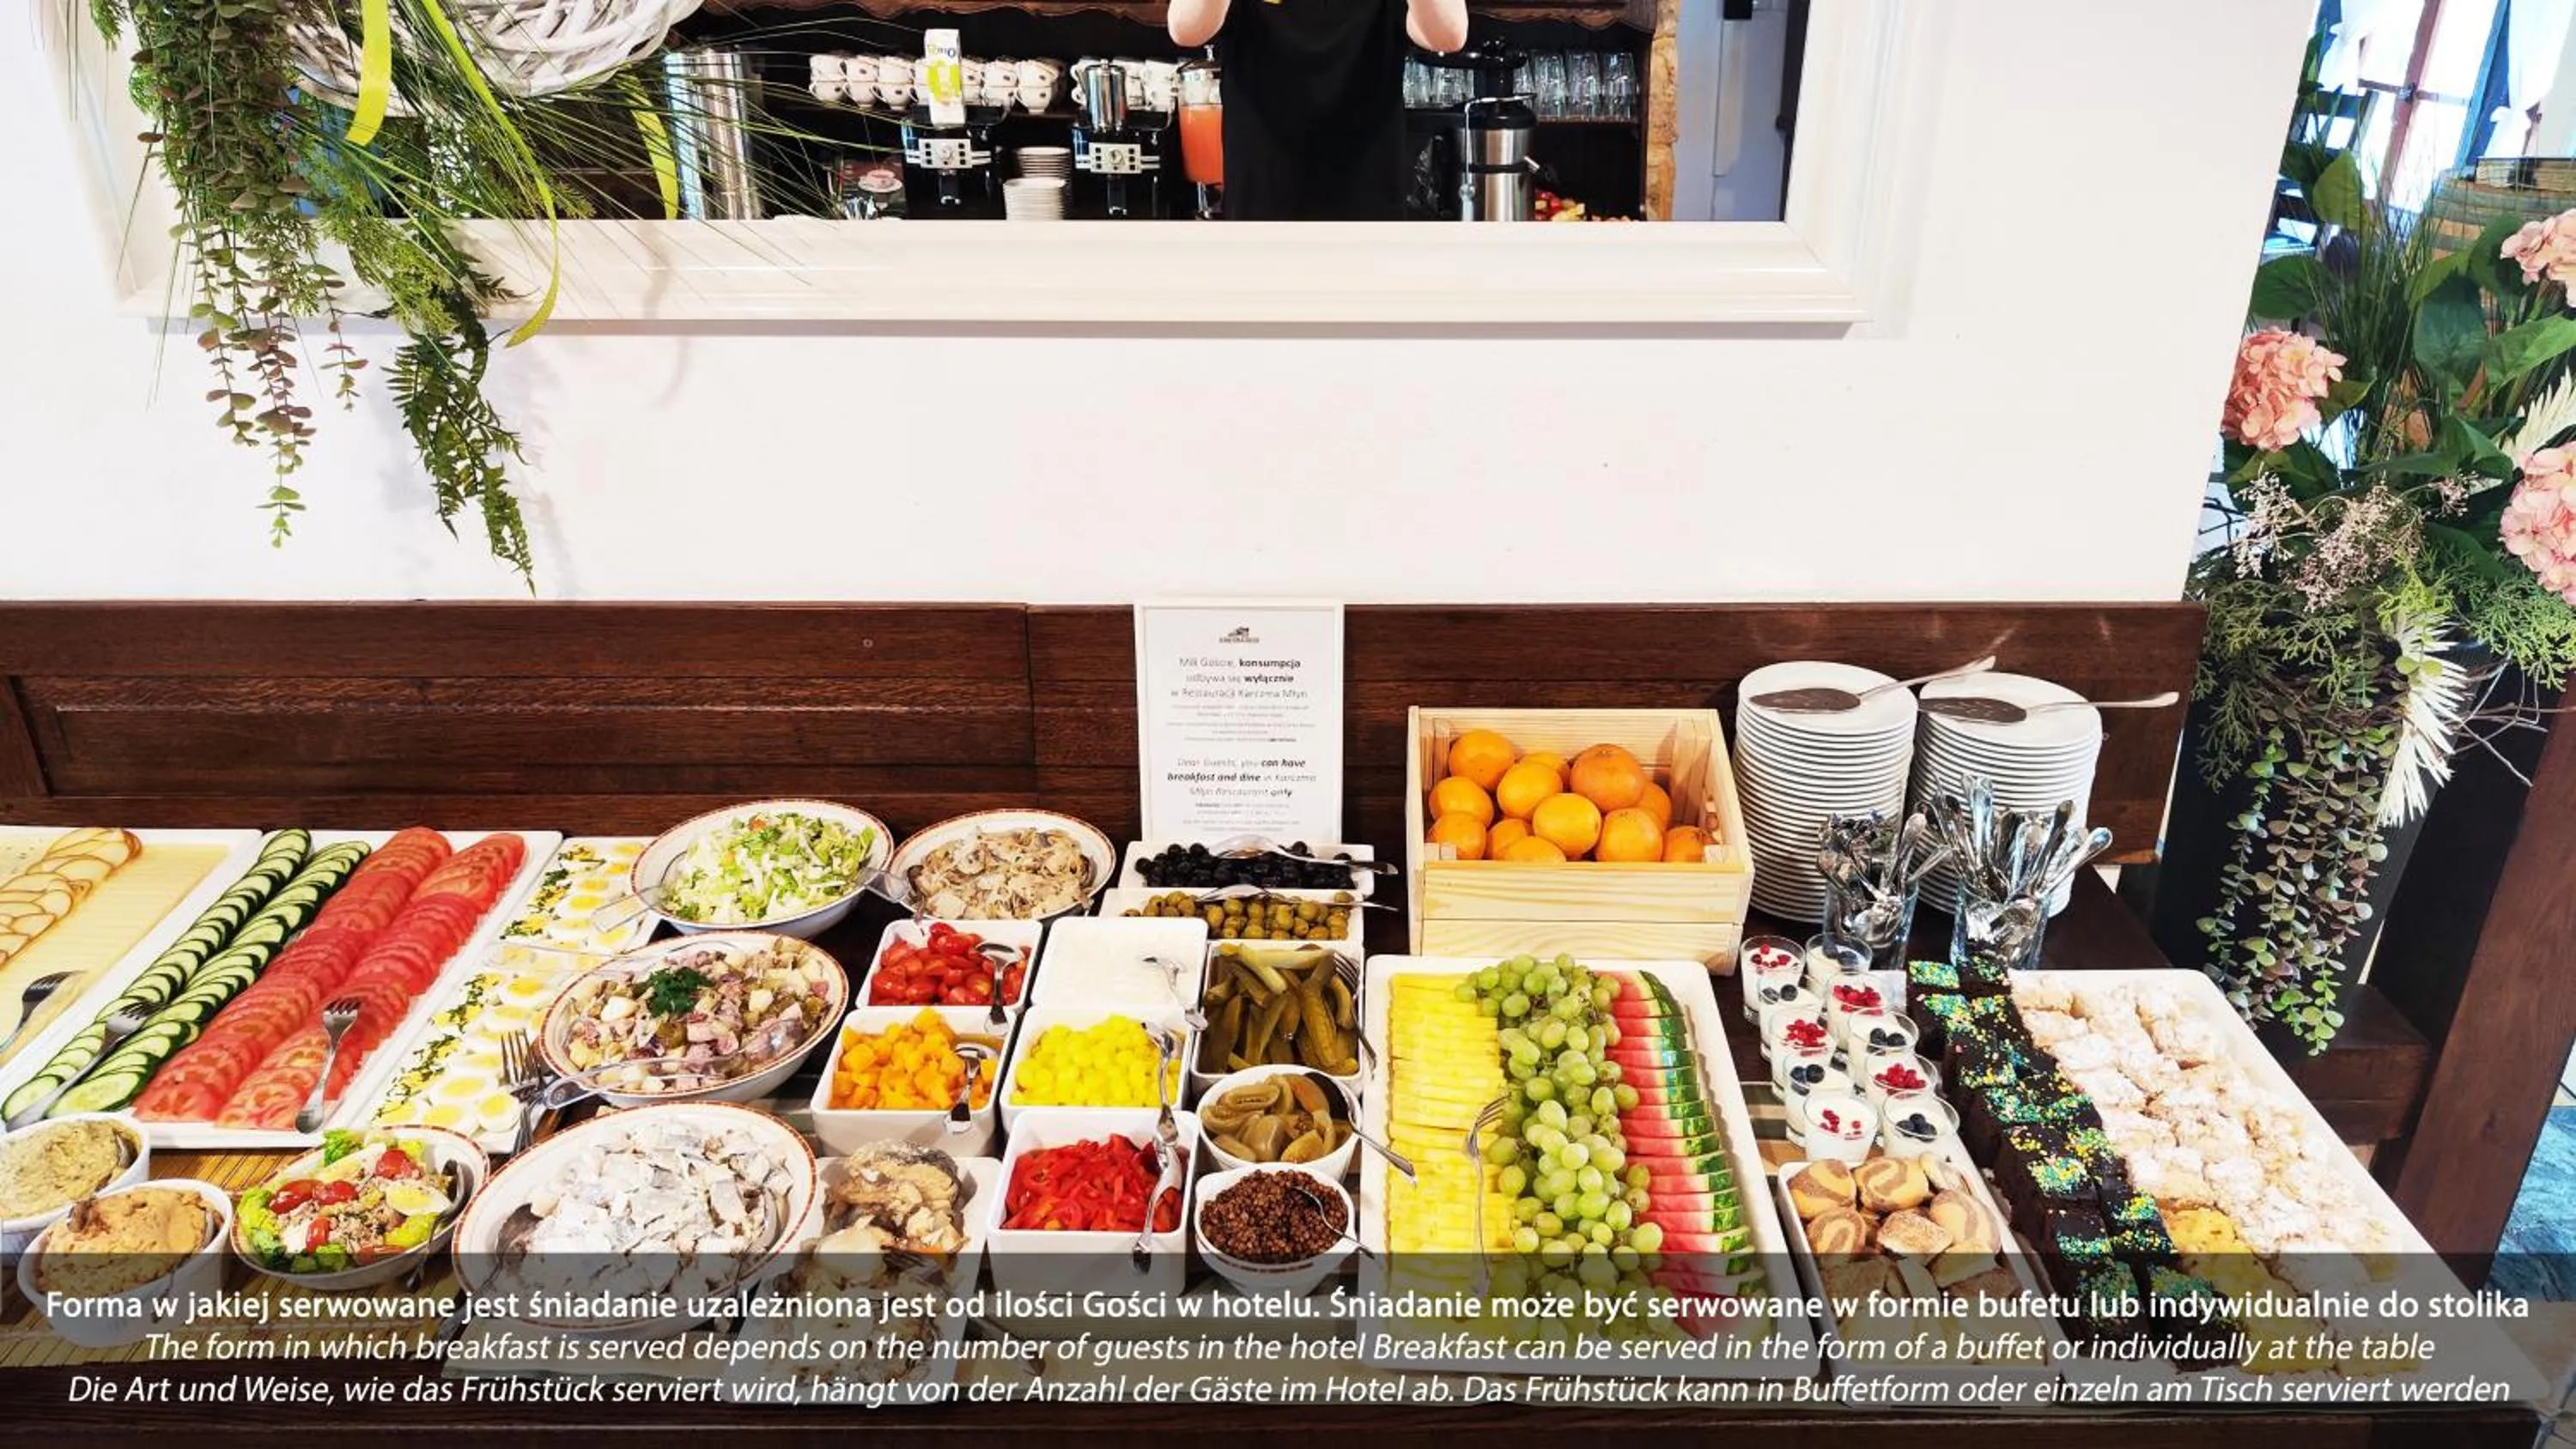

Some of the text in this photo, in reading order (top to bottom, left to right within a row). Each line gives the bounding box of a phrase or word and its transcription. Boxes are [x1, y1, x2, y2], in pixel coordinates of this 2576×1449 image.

[1239, 658, 1301, 669] konsumpcja
[1244, 674, 1294, 684] wyłącznie
[1281, 758, 1306, 767] have
[1167, 772, 1216, 782] breakfast
[1217, 773, 1237, 782] and
[1239, 773, 1261, 782] dine
[1270, 787, 1292, 797] only
